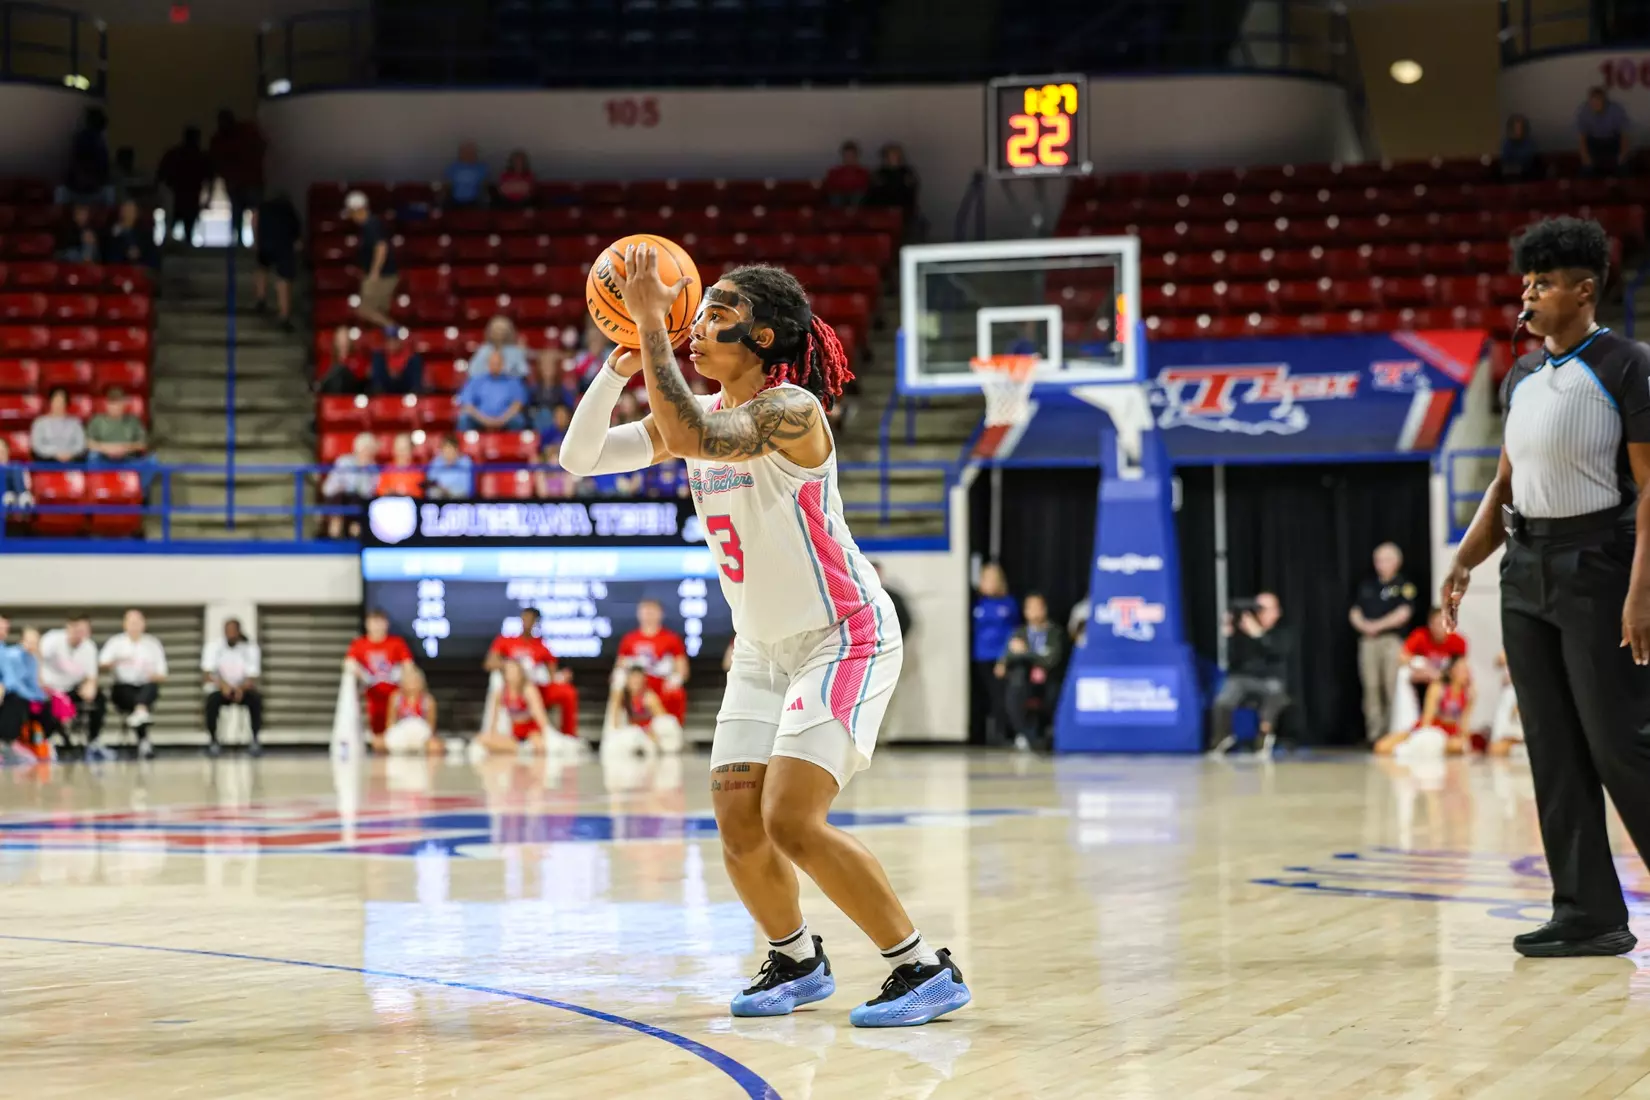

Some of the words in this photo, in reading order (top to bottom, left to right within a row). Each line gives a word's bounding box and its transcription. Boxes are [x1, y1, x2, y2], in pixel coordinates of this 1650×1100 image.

[604, 97, 661, 129] 105
[1007, 113, 1070, 167] 22
[706, 514, 744, 583] 3
